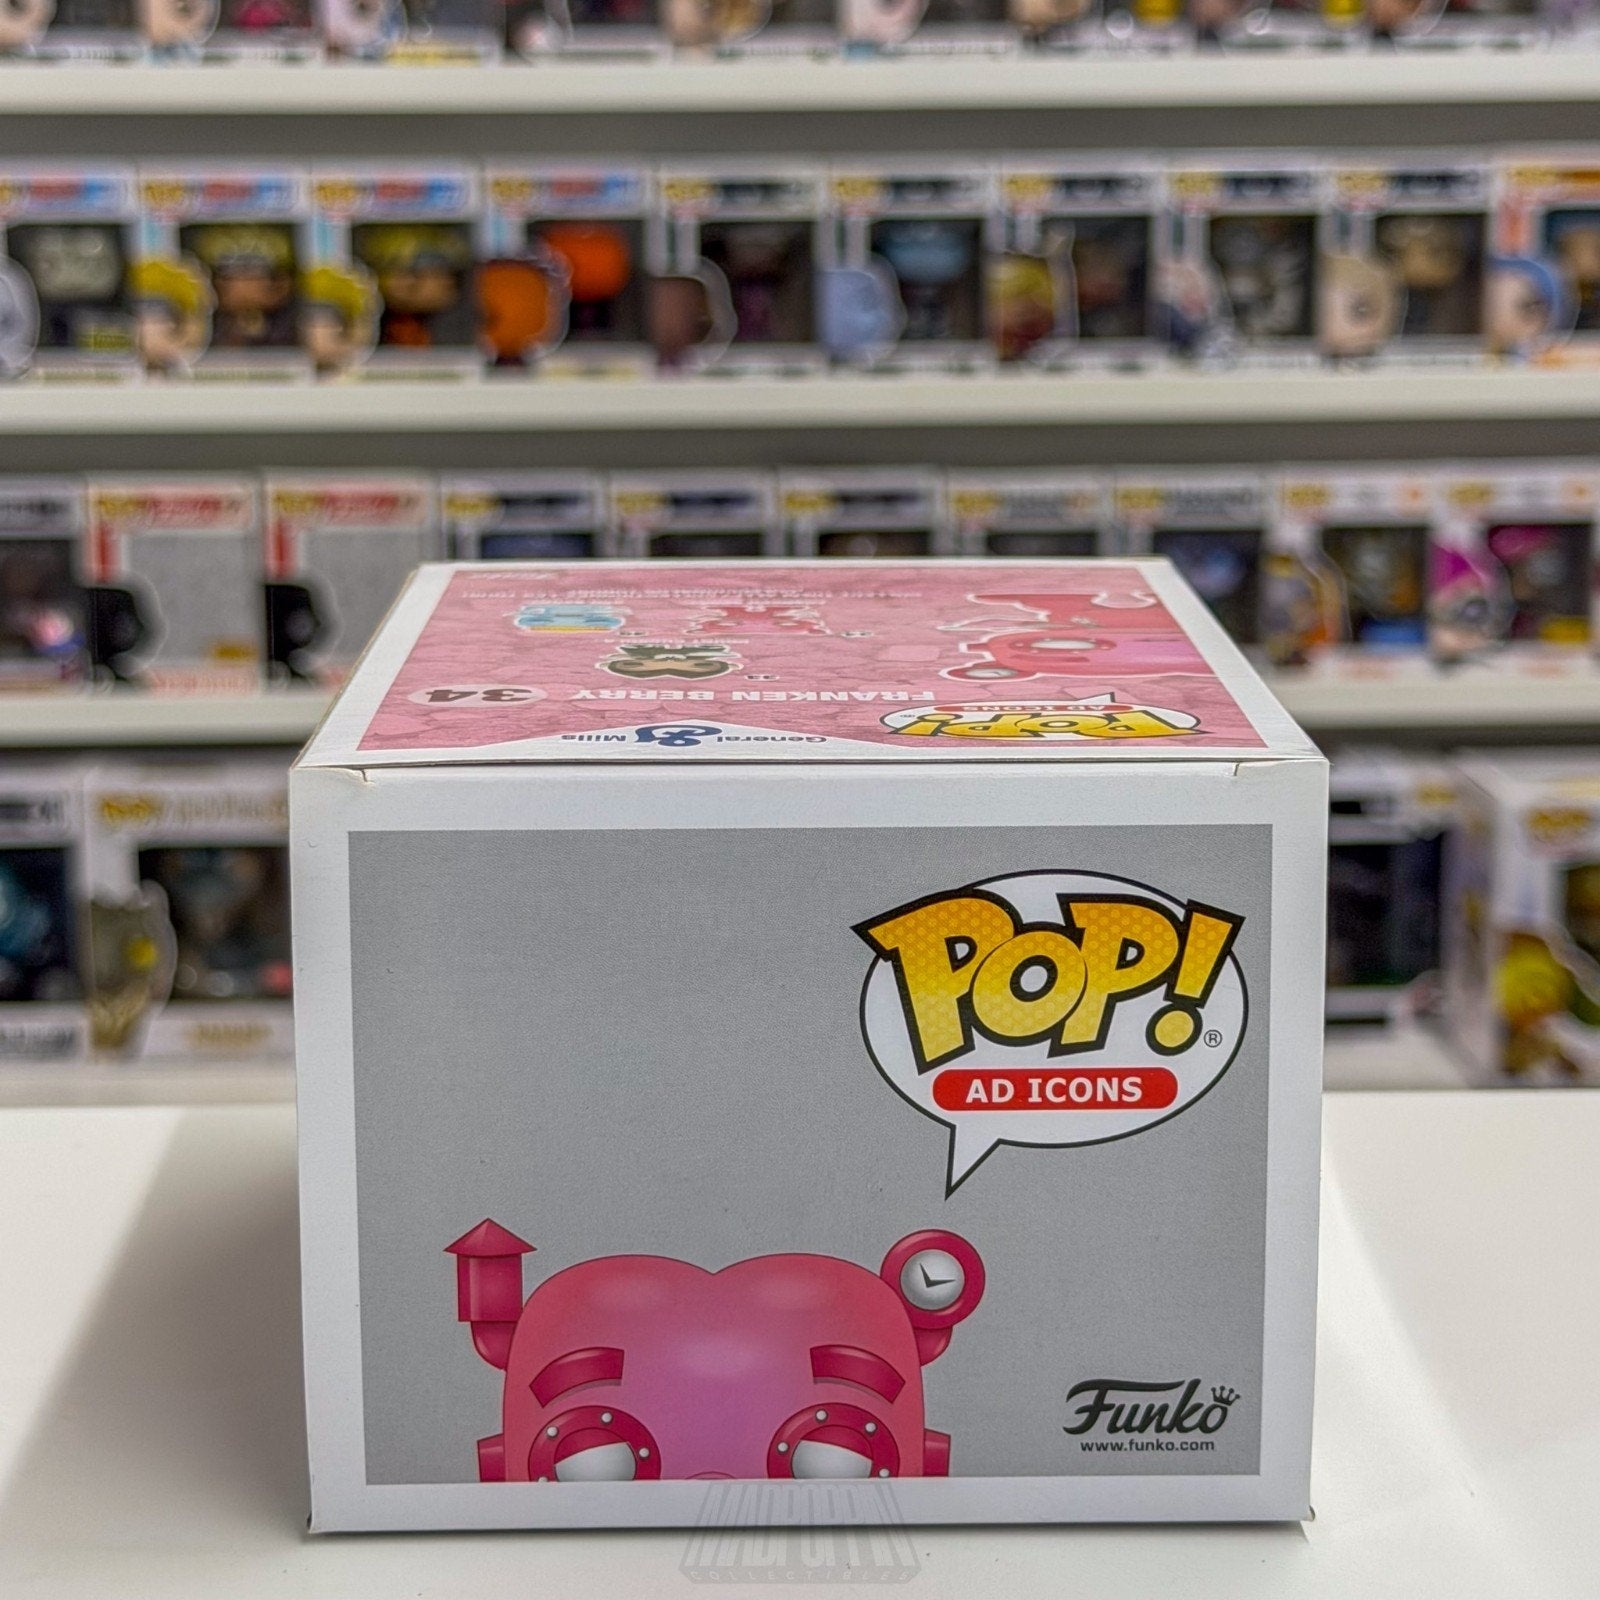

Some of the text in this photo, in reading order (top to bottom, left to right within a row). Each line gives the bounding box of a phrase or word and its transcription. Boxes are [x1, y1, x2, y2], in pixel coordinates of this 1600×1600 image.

[425, 688, 532, 703] 34
[572, 689, 935, 701] FRANKEN BERRY
[886, 709, 1214, 739] POP!
[561, 734, 627, 742] Mills
[717, 735, 827, 743] General
[849, 887, 1247, 1076] POP!
[965, 1076, 1143, 1104] AD ICONS
[1062, 1378, 1229, 1435] Funko
[1080, 1438, 1215, 1452] www.funko.com
